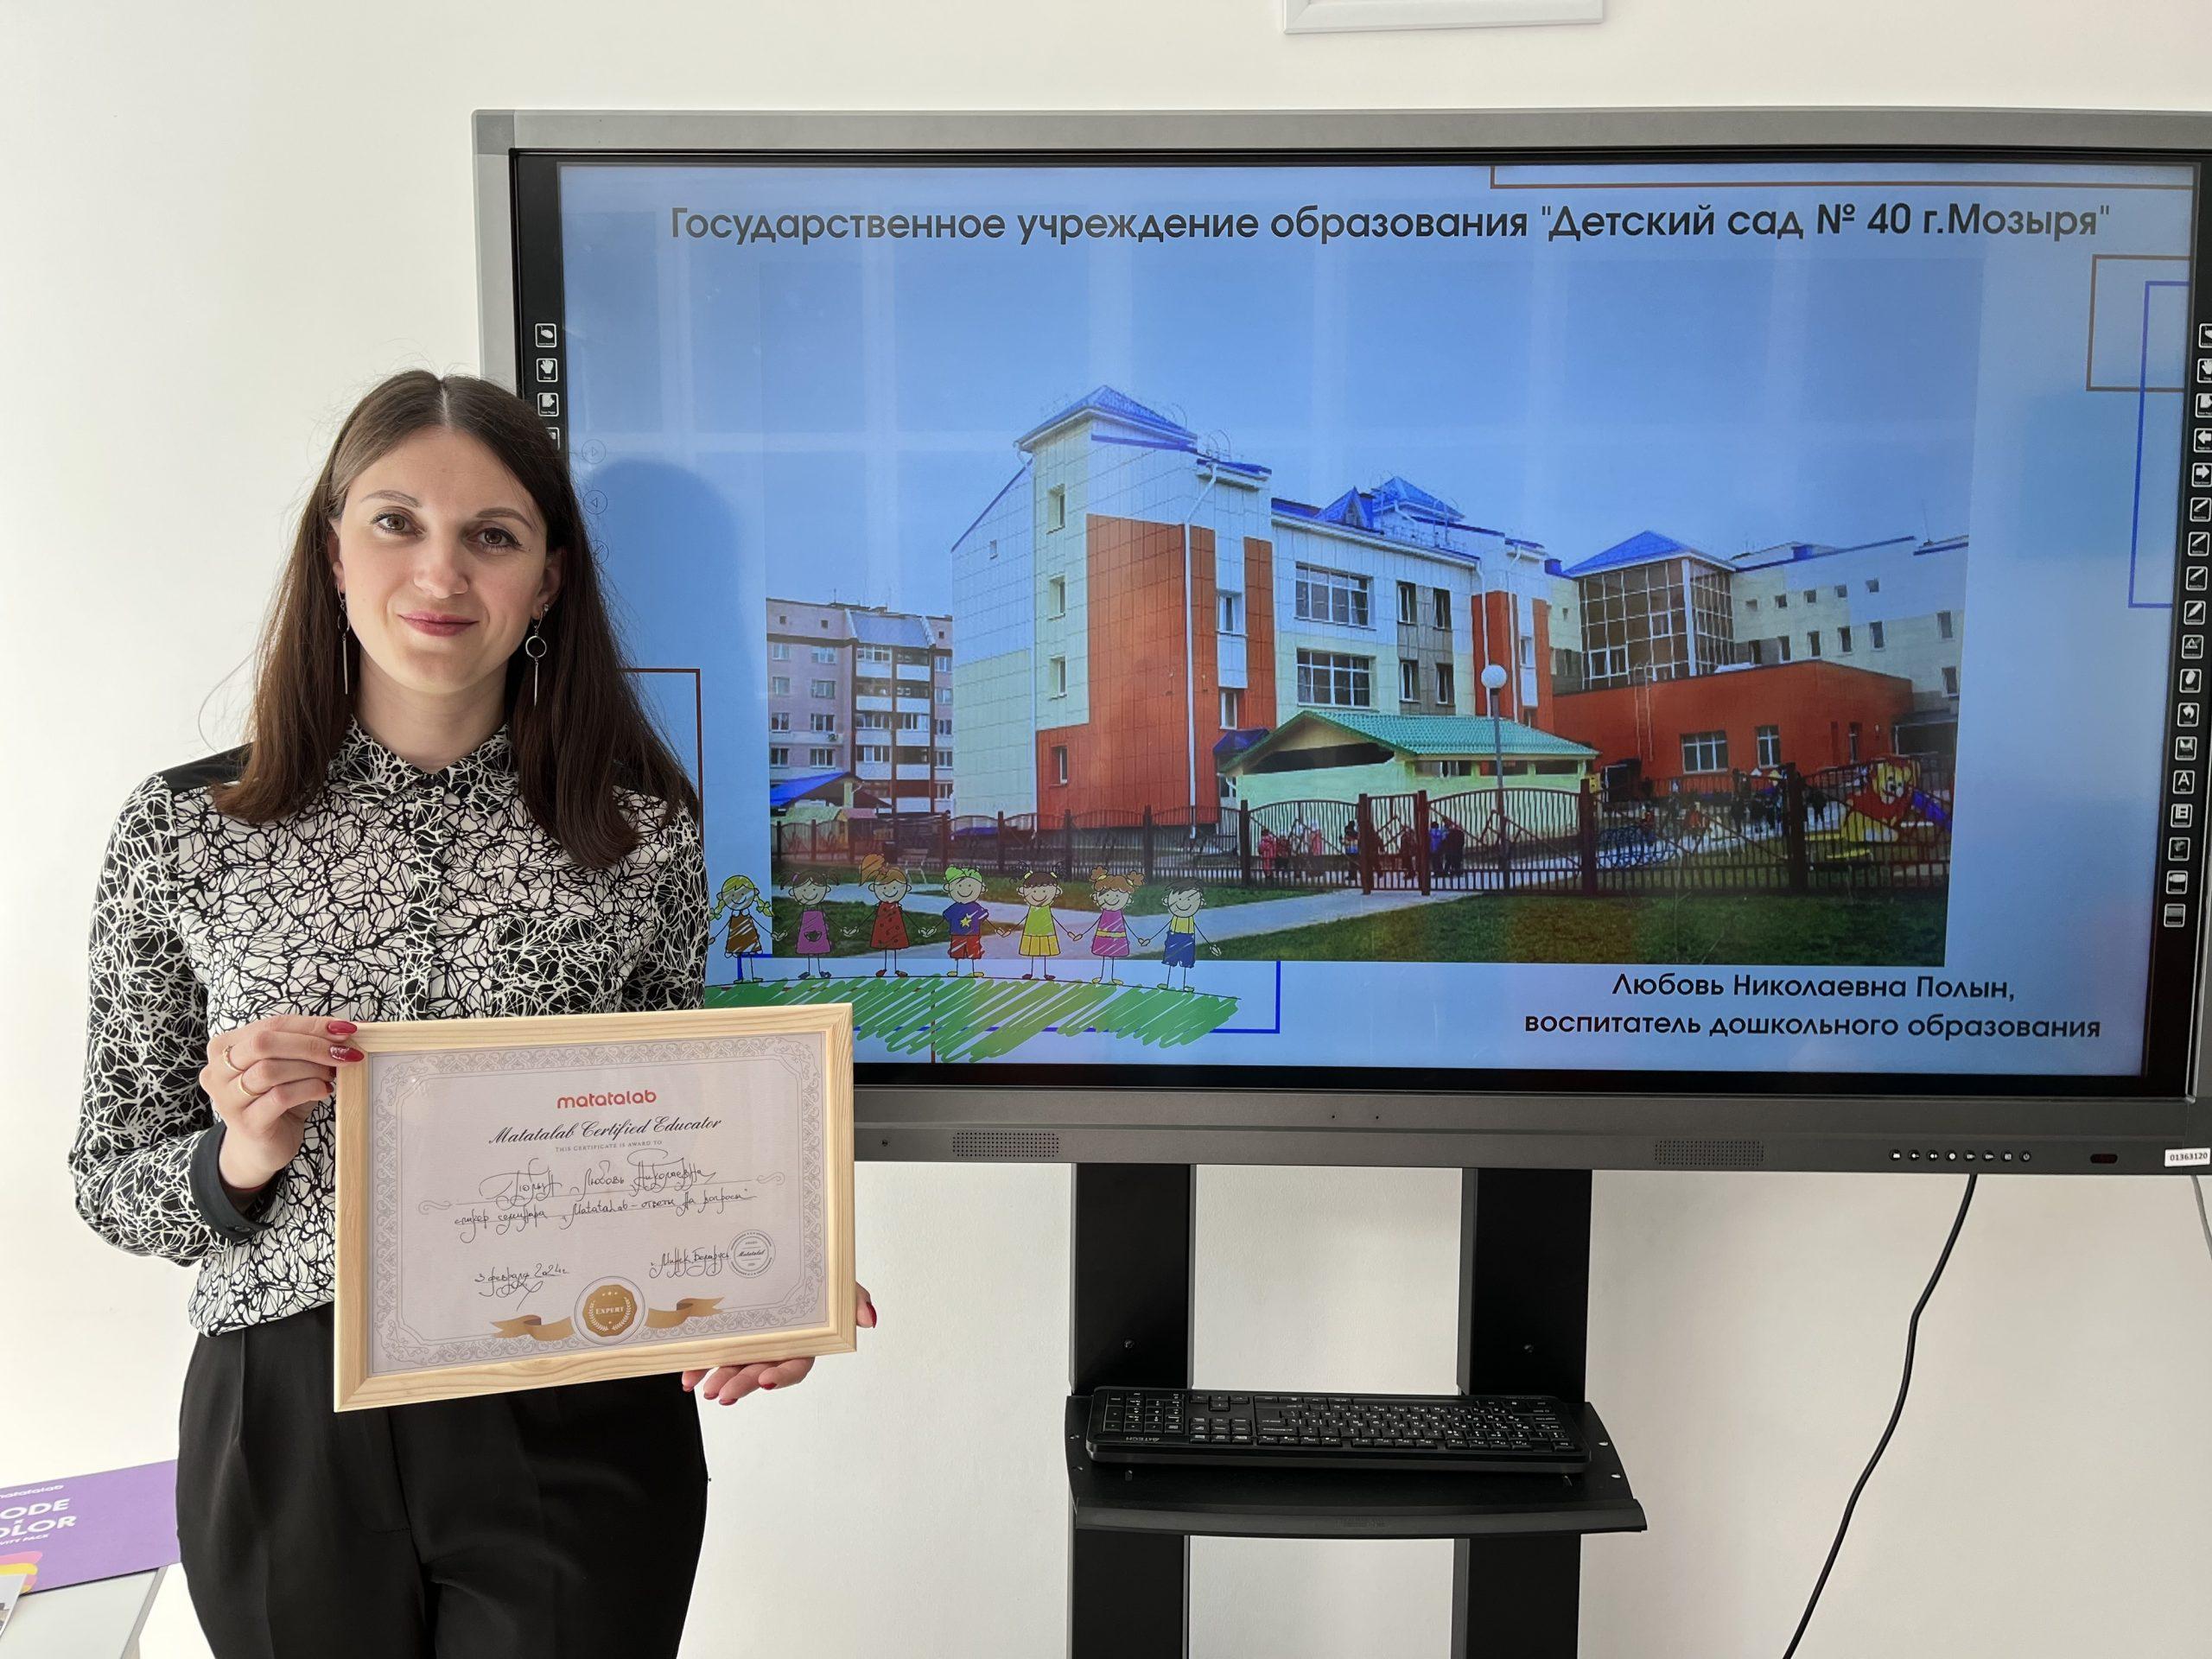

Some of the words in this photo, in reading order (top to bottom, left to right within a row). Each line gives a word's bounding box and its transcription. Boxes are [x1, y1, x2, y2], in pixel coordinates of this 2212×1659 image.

[671, 207, 1005, 245] Государственное
[1016, 213, 1258, 245] учреждение
[1270, 204, 1528, 245] образования
[1541, 204, 1715, 243] "Детский
[1727, 210, 1804, 240] сад
[1816, 203, 1856, 236] №
[1866, 202, 1911, 236] 40
[1923, 202, 2110, 243] г.Мозыря"
[1611, 972, 1725, 996] Любовь
[1733, 974, 1907, 998] Николаевна
[1916, 975, 2015, 1001] Полын,
[1525, 1014, 1701, 1034] воспитатель
[1708, 1016, 1899, 1038] дошкольного
[1907, 1013, 2101, 1042] образования
[556, 1090, 657, 1109] matatalab
[488, 1123, 579, 1145] Matatalab
[581, 1118, 652, 1141] Certified
[653, 1116, 722, 1134] Educator
[595, 1306, 624, 1315] EXPERT
[0, 1498, 71, 1520] ODE
